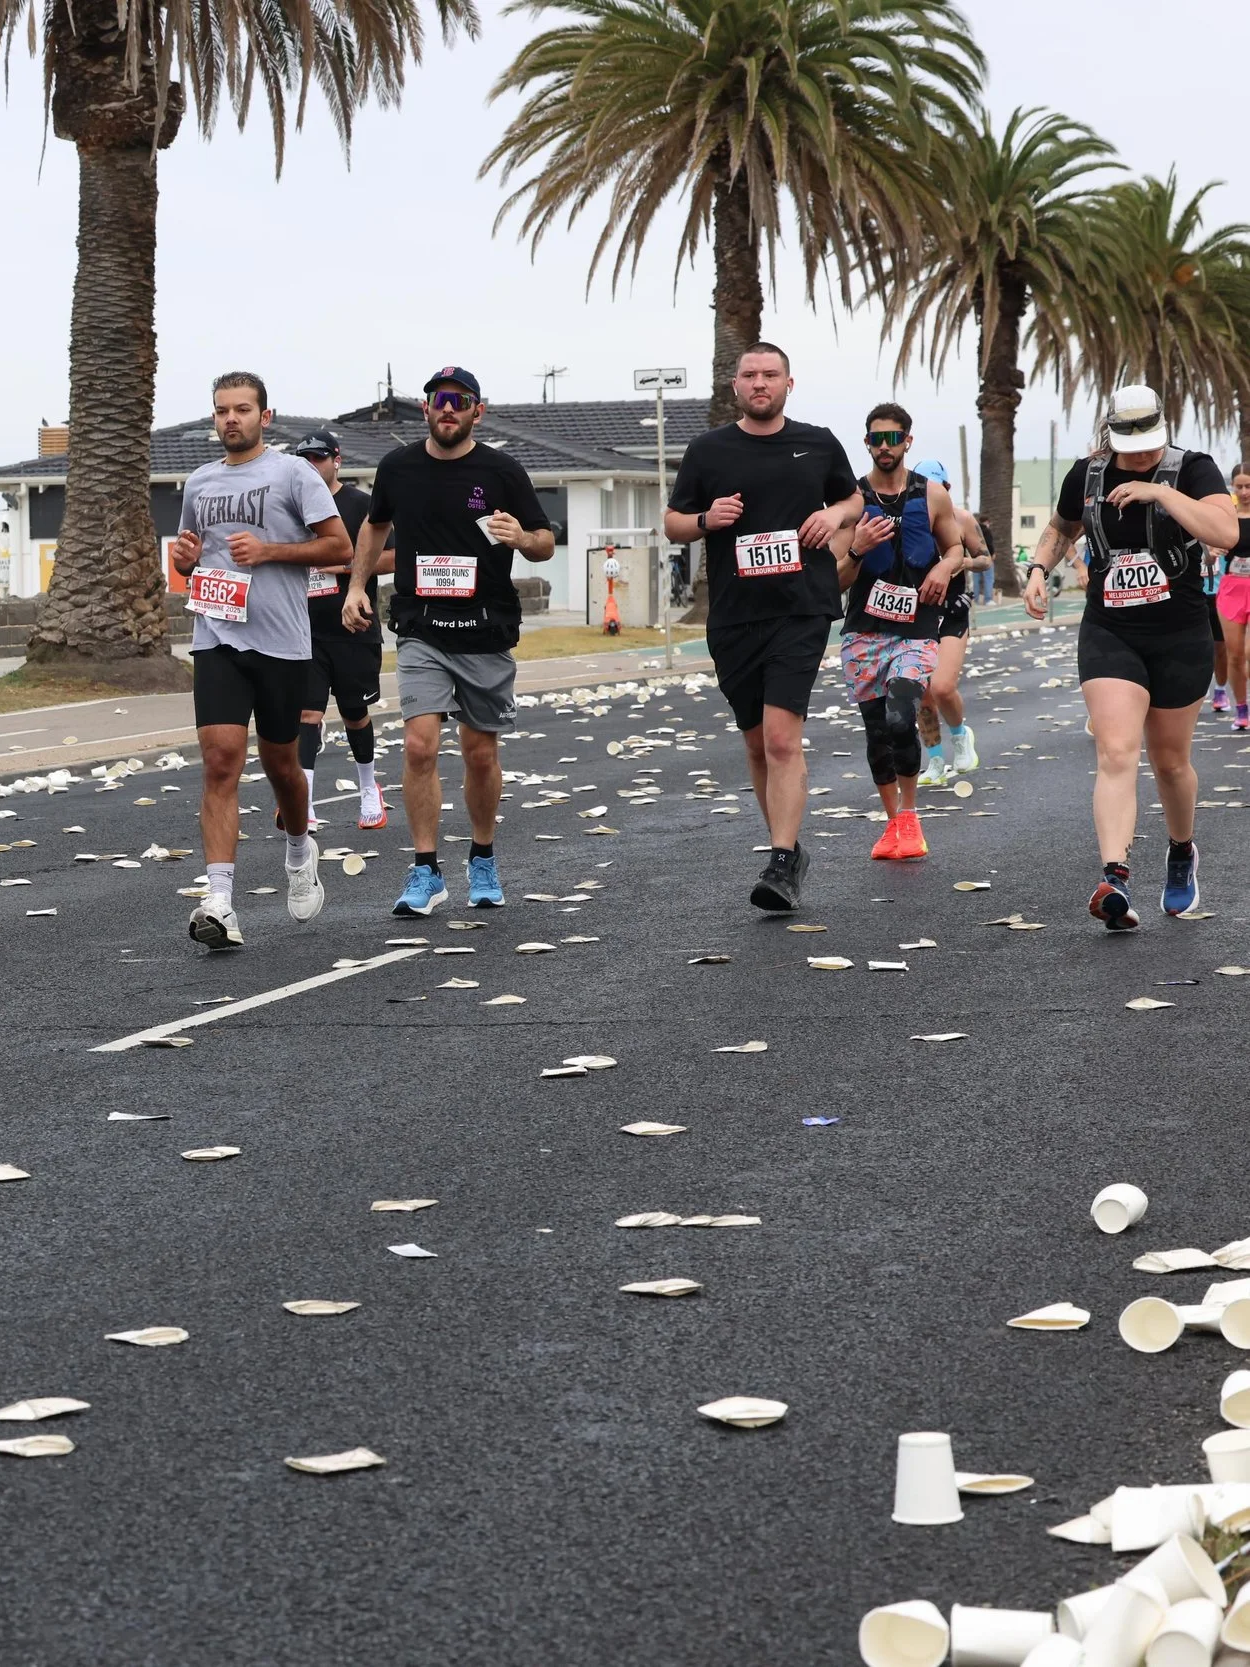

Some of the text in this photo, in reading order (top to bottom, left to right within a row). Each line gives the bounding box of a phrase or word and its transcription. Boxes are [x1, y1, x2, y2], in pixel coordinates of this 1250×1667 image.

[747, 543, 792, 567] 15115
[422, 567, 470, 578] RAMMBO RUNS
[744, 564, 796, 576] MELBOURNE 2025
[435, 578, 456, 587] 10994
[200, 578, 238, 605] 6562
[1108, 587, 1163, 599] MELBOURNE 2025
[193, 601, 225, 611] MELBOURNE
[225, 605, 242, 614] 2025
[873, 590, 913, 614] 14345
[867, 607, 896, 620] MELBOURNE
[432, 619, 477, 628] nerd belt
